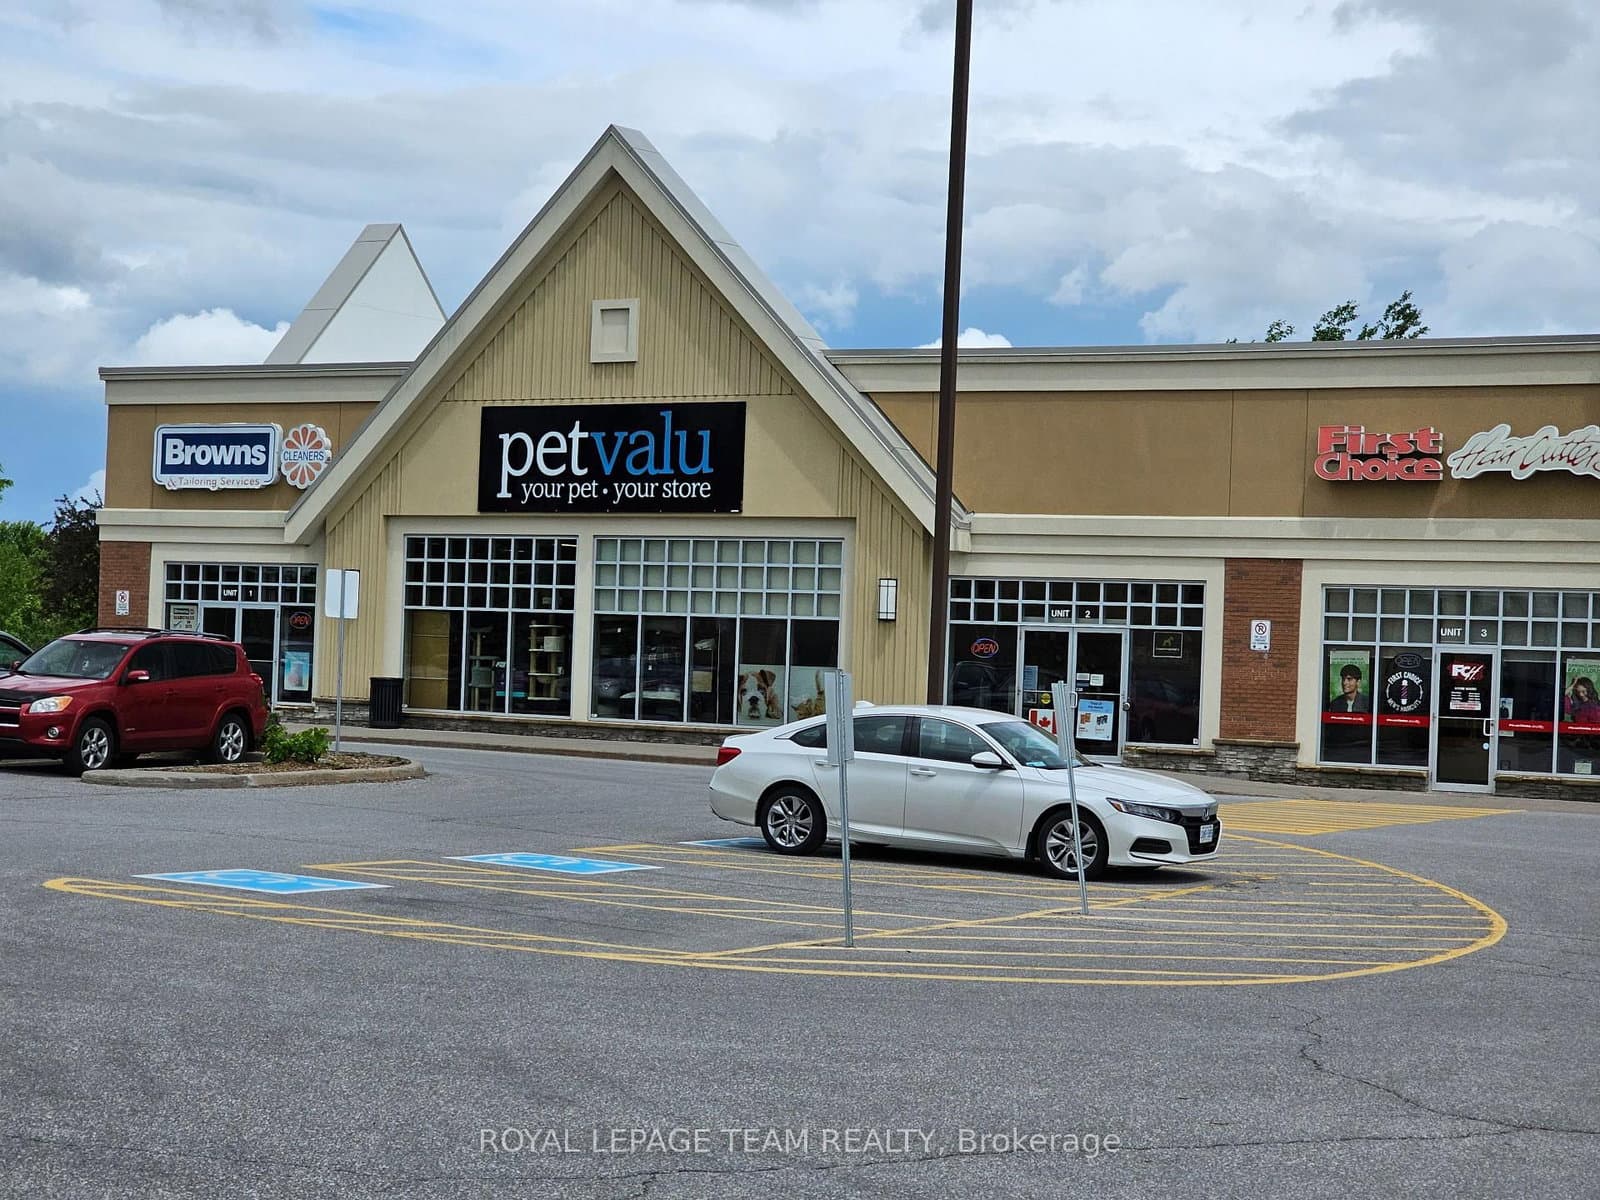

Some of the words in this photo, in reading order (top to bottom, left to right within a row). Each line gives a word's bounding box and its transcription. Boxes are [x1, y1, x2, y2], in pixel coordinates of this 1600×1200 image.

[1317, 425, 1443, 455] First
[165, 438, 266, 466] Browns
[284, 451, 324, 462] CLEANERS
[1453, 436, 1526, 471] Hair
[1314, 450, 1443, 480] Choice
[179, 477, 217, 488] Tailoring
[220, 478, 260, 486] Services
[521, 481, 565, 504] your
[568, 480, 599, 504] pet
[612, 481, 659, 504] your
[662, 480, 711, 498] store
[223, 589, 238, 597] UNIT
[1051, 609, 1071, 618] UNIT
[1084, 610, 1091, 618] 2
[1440, 628, 1462, 637] UNIT
[1480, 628, 1488, 637] 3
[972, 643, 997, 654] OPEN
[1387, 671, 1403, 685] FIRST
[1403, 671, 1423, 686] CHOICE
